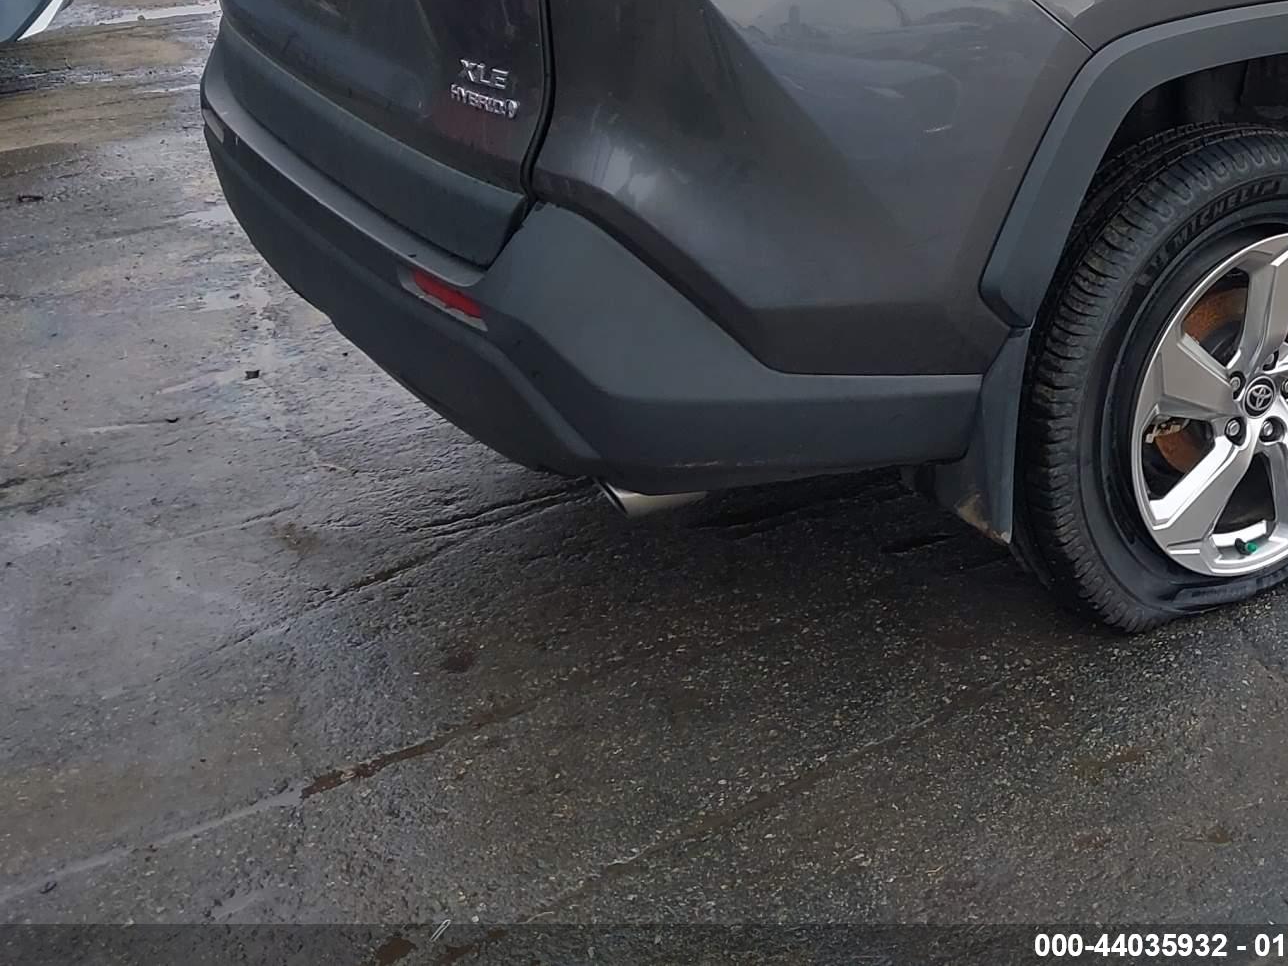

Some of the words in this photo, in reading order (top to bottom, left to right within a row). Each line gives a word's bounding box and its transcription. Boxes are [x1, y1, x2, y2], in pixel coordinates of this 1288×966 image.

[459, 58, 509, 90] XLE
[450, 83, 507, 115] HYBRID
[1174, 178, 1282, 248] MICHELIN
